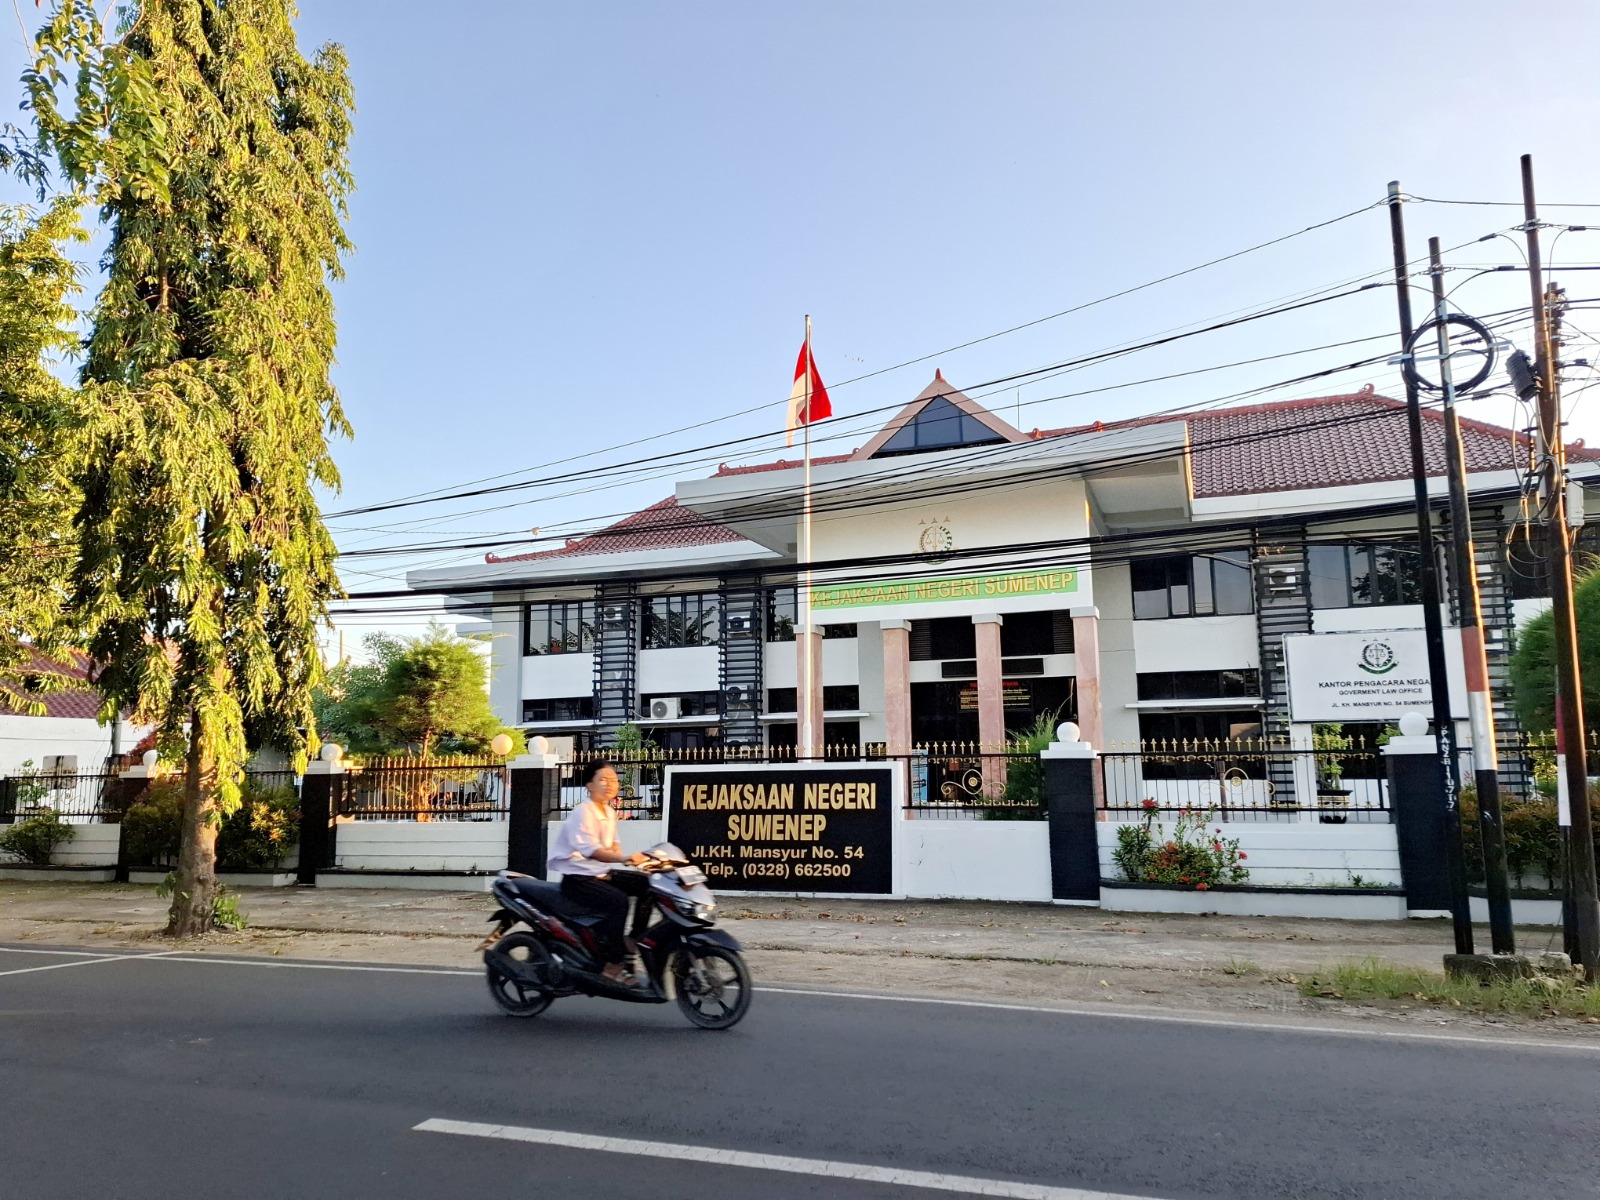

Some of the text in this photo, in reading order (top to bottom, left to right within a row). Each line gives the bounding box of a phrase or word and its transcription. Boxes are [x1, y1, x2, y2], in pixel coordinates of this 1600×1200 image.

[809, 572, 1073, 607] KEJAKSAAN NEGERI SUMENEP
[1353, 679, 1405, 687] PENGACARA
[1407, 678, 1432, 686] NEGA
[682, 782, 876, 810] KEJAKSAAN NEGERI
[727, 814, 826, 841] SUMENEP
[740, 846, 807, 862] Mansyur
[812, 846, 839, 859] No.
[843, 846, 864, 859] 54
[702, 862, 738, 878] Telp.
[742, 863, 790, 879] (0328)
[794, 863, 851, 877] 662500
